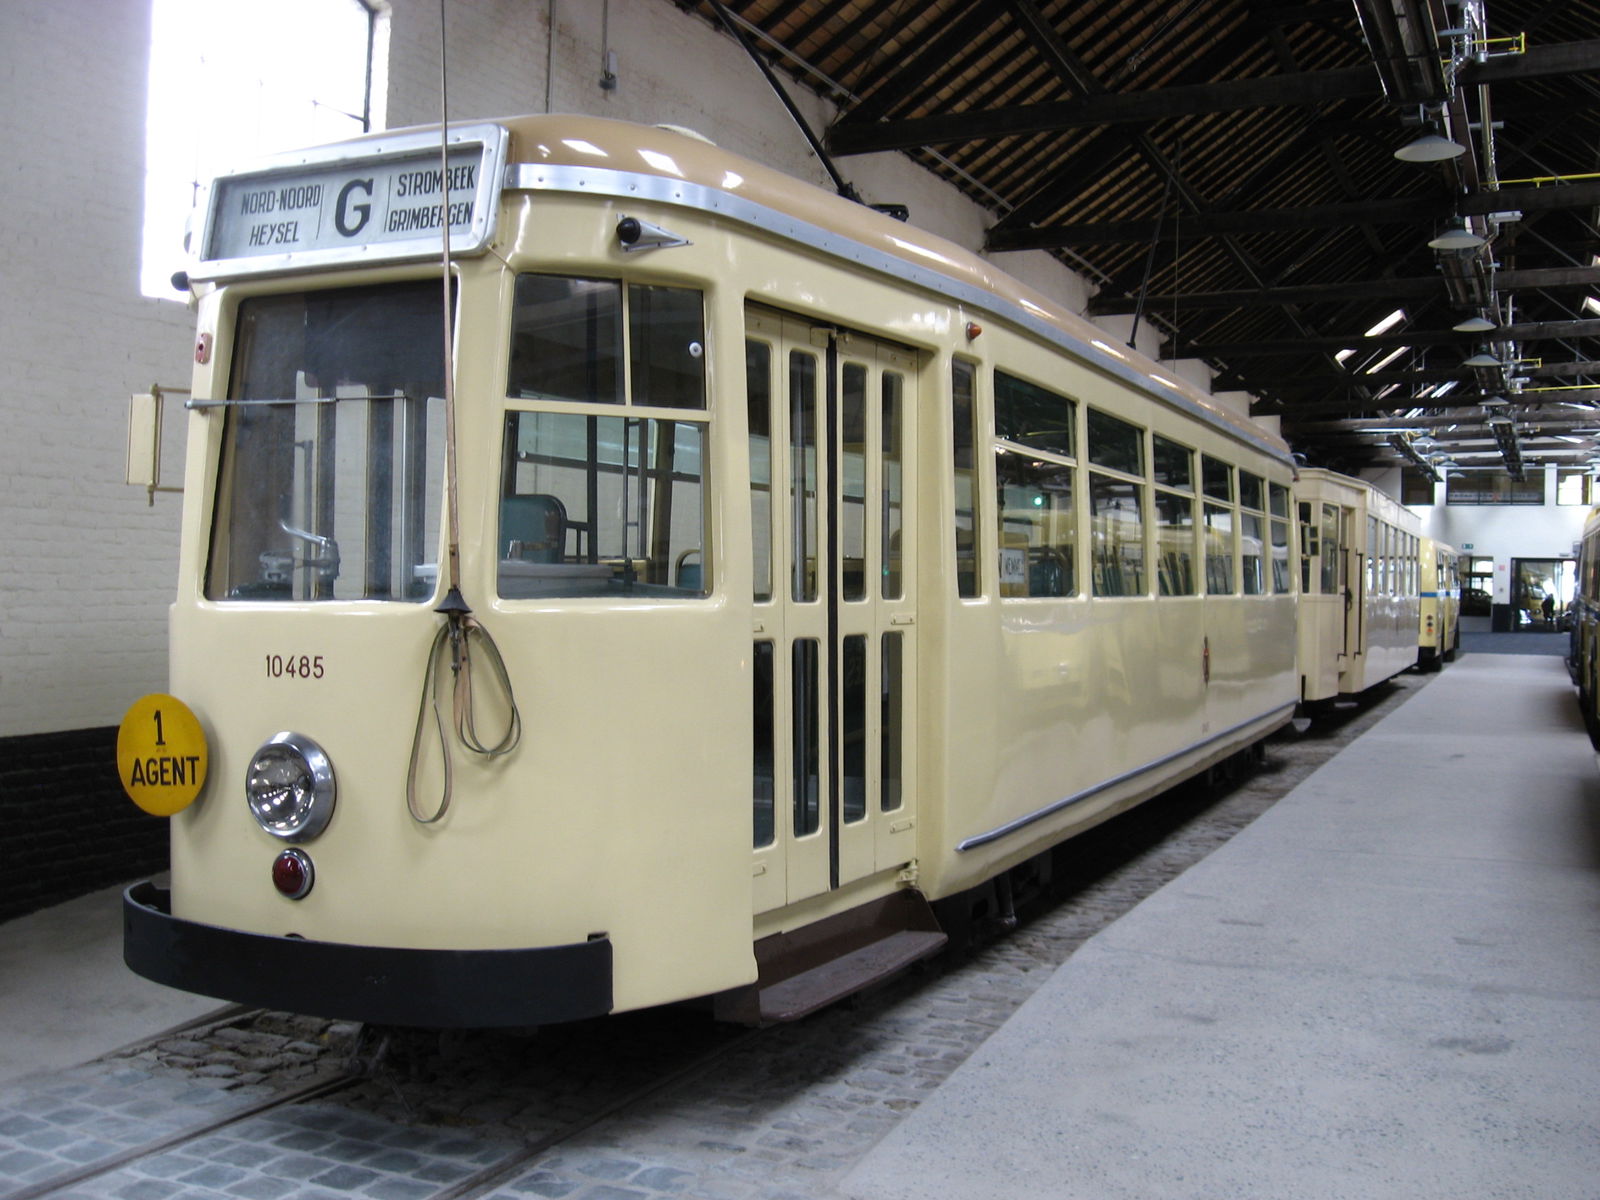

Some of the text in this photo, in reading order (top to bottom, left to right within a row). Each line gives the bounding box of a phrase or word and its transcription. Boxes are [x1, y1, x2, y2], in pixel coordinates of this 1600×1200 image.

[397, 165, 475, 197] STROMBEEK
[240, 184, 321, 216] NORD-NOORD
[335, 178, 374, 238] G
[388, 201, 474, 233] GRIMBERGEN
[248, 220, 300, 247] HEYSEL
[265, 654, 324, 679] 10485
[153, 709, 166, 747] 1
[130, 755, 200, 787] AGENT
